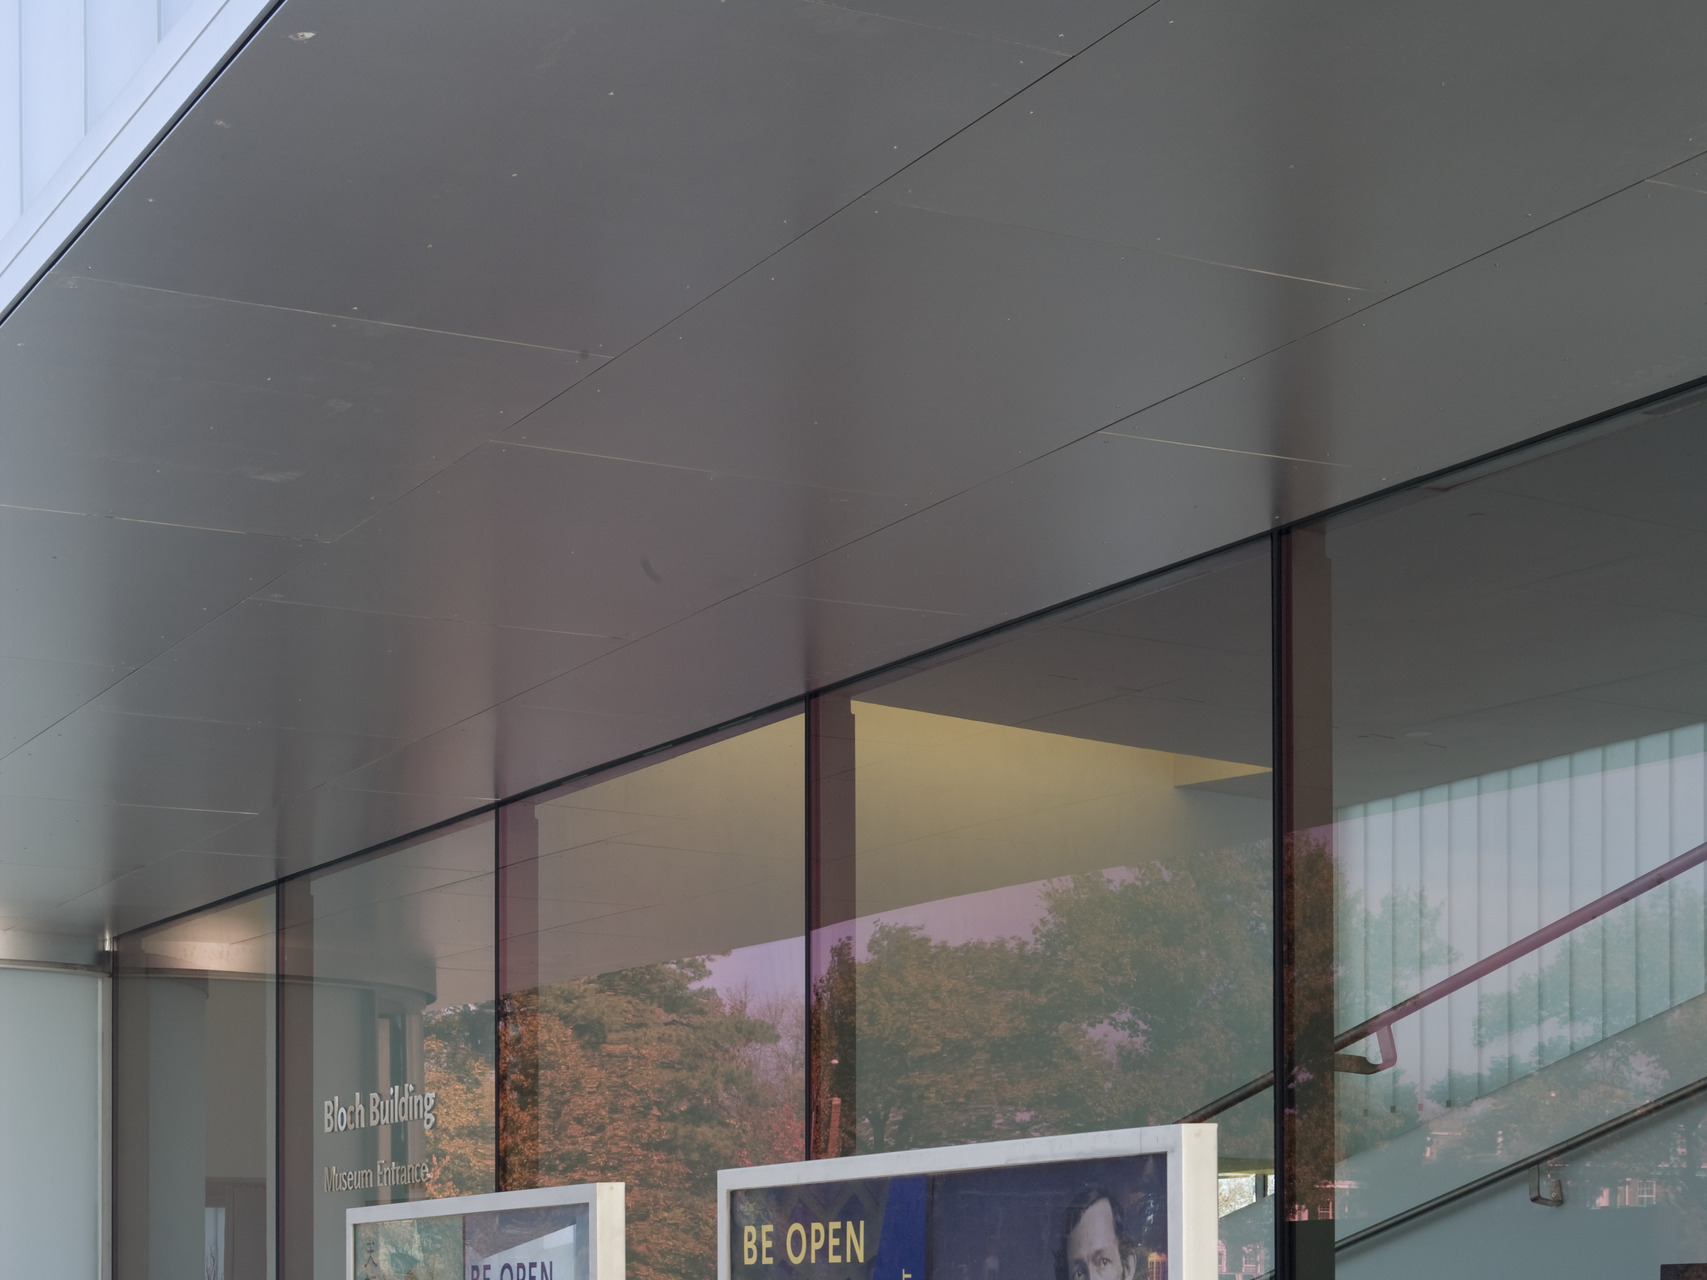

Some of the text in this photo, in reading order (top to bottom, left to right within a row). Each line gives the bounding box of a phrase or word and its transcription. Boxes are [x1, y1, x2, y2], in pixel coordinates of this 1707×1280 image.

[324, 1083, 436, 1133] Bloch Building
[324, 1160, 430, 1193] Museum Entrance
[744, 1220, 865, 1265] BE OPEN
